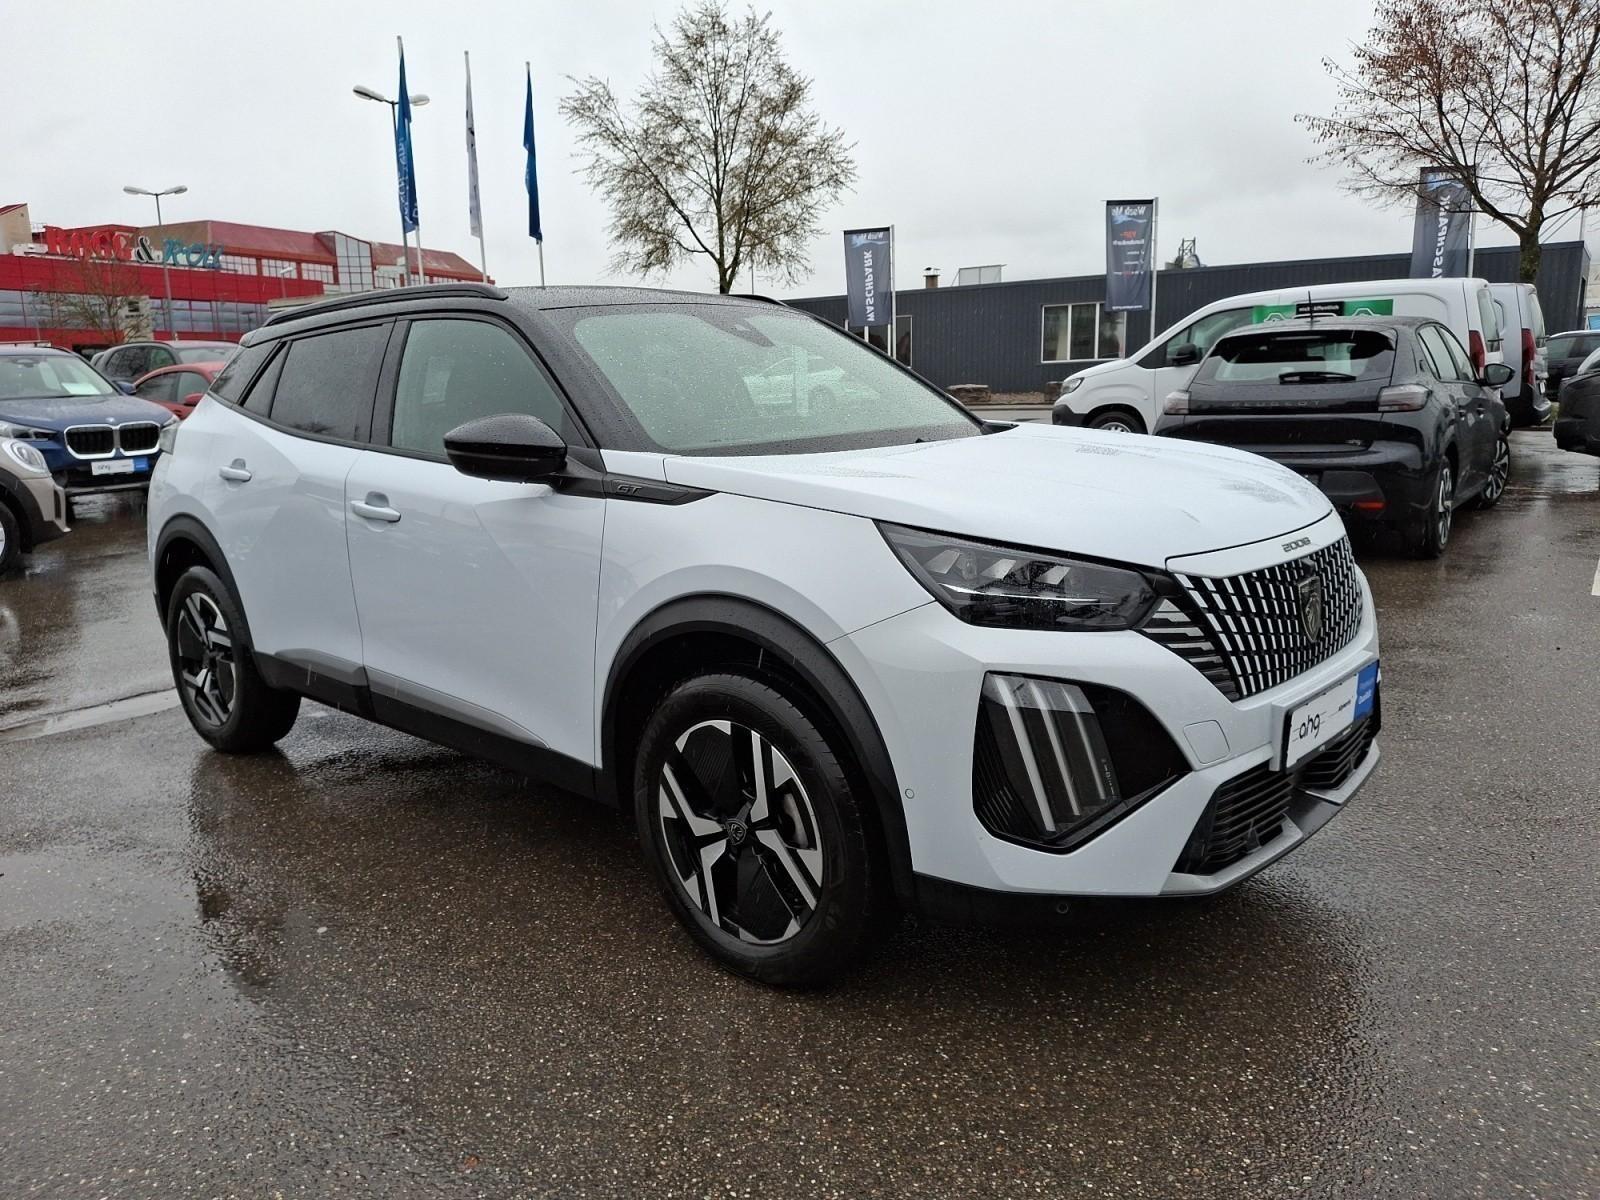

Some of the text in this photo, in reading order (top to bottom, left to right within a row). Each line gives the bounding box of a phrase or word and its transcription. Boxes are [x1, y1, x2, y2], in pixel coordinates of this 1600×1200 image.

[135, 236, 154, 263] &
[618, 484, 643, 496] GT
[1281, 537, 1312, 553] 2008
[1299, 713, 1321, 740] ahg
